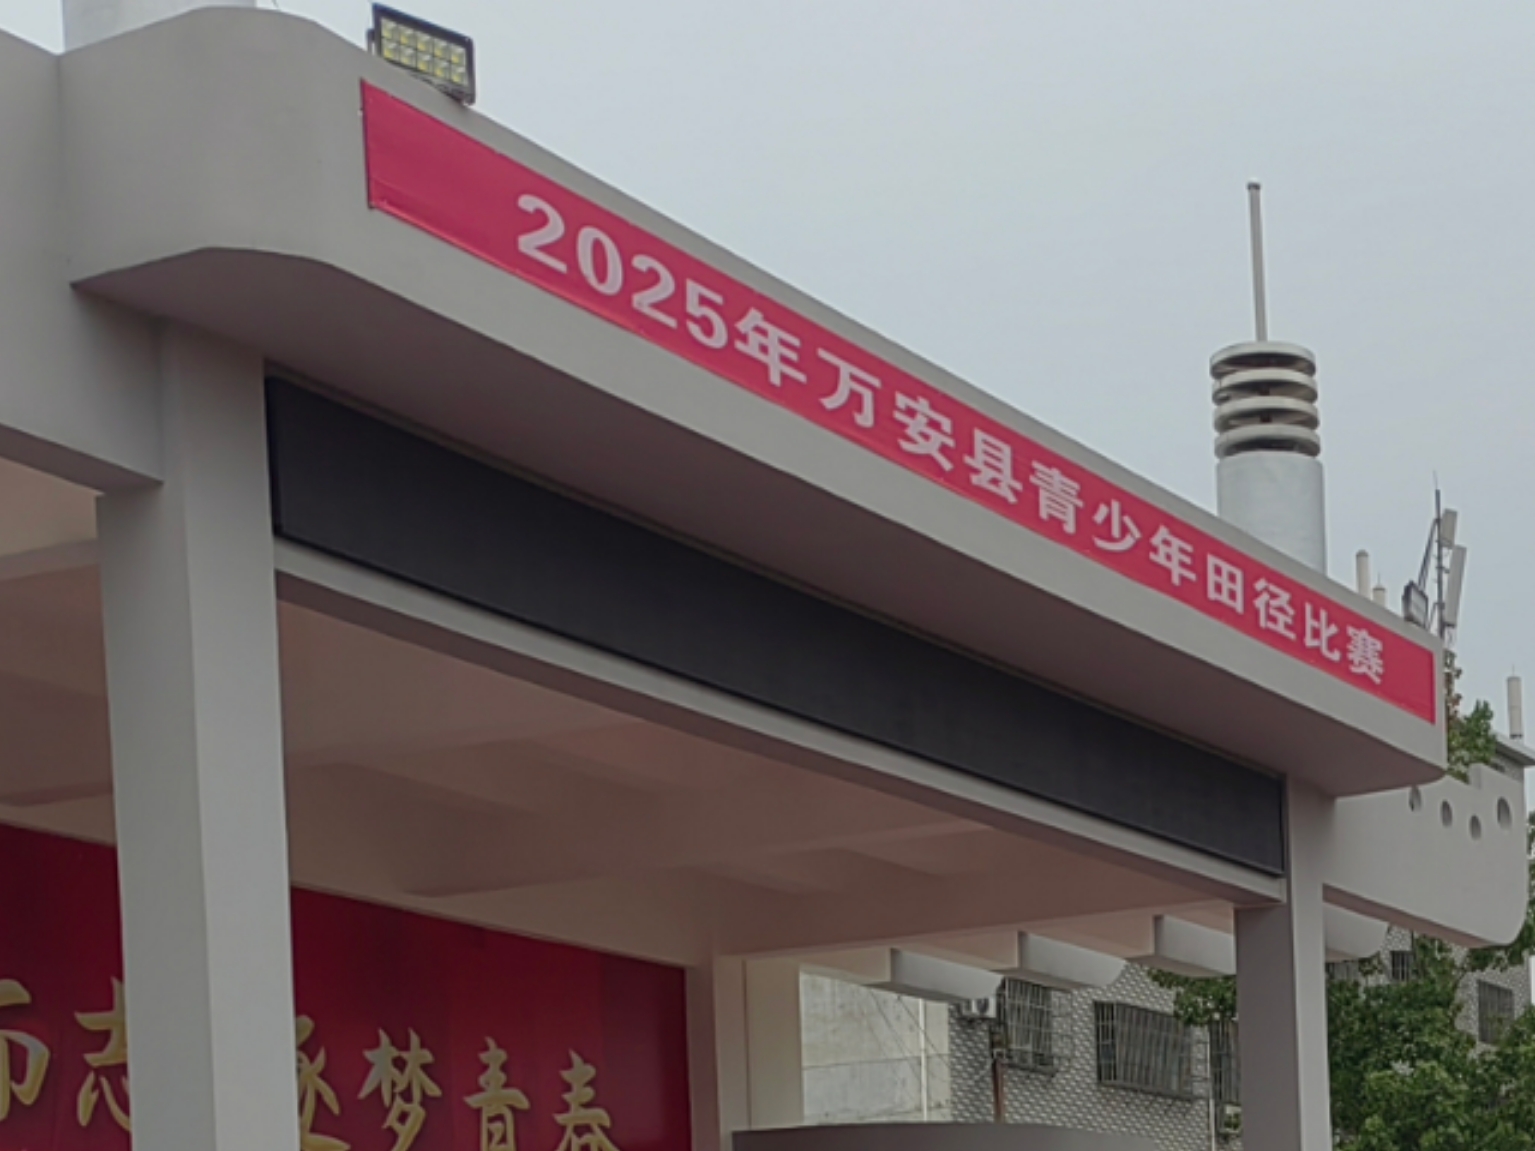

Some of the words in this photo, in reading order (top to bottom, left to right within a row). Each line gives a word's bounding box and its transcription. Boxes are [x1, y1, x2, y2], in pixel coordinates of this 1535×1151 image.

[516, 193, 1384, 684] 2025年万安县青少年田径比赛
